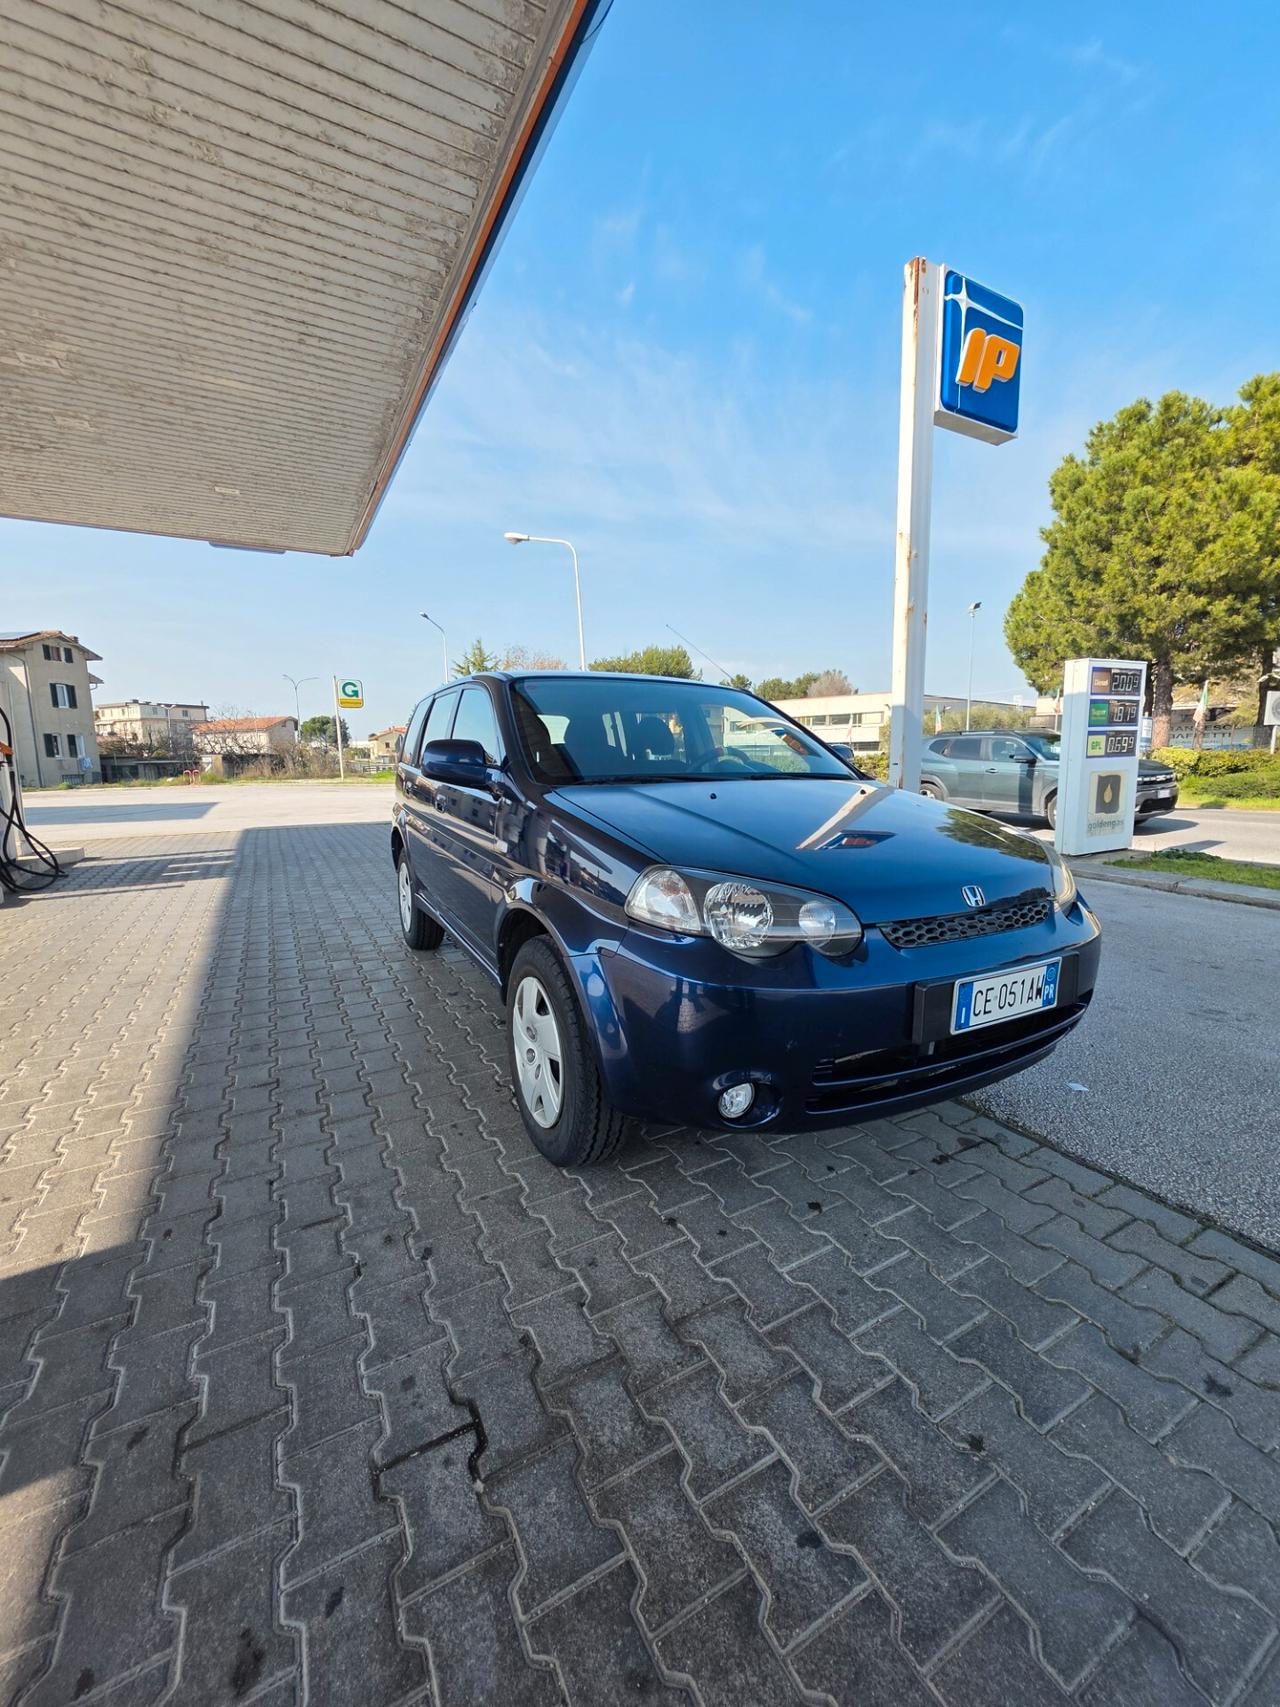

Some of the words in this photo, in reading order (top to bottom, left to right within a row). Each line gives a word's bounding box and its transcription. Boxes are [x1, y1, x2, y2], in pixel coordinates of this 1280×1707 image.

[342, 682, 359, 698] G
[1088, 819, 1124, 831] goldengas
[1044, 983, 1054, 1000] PR
